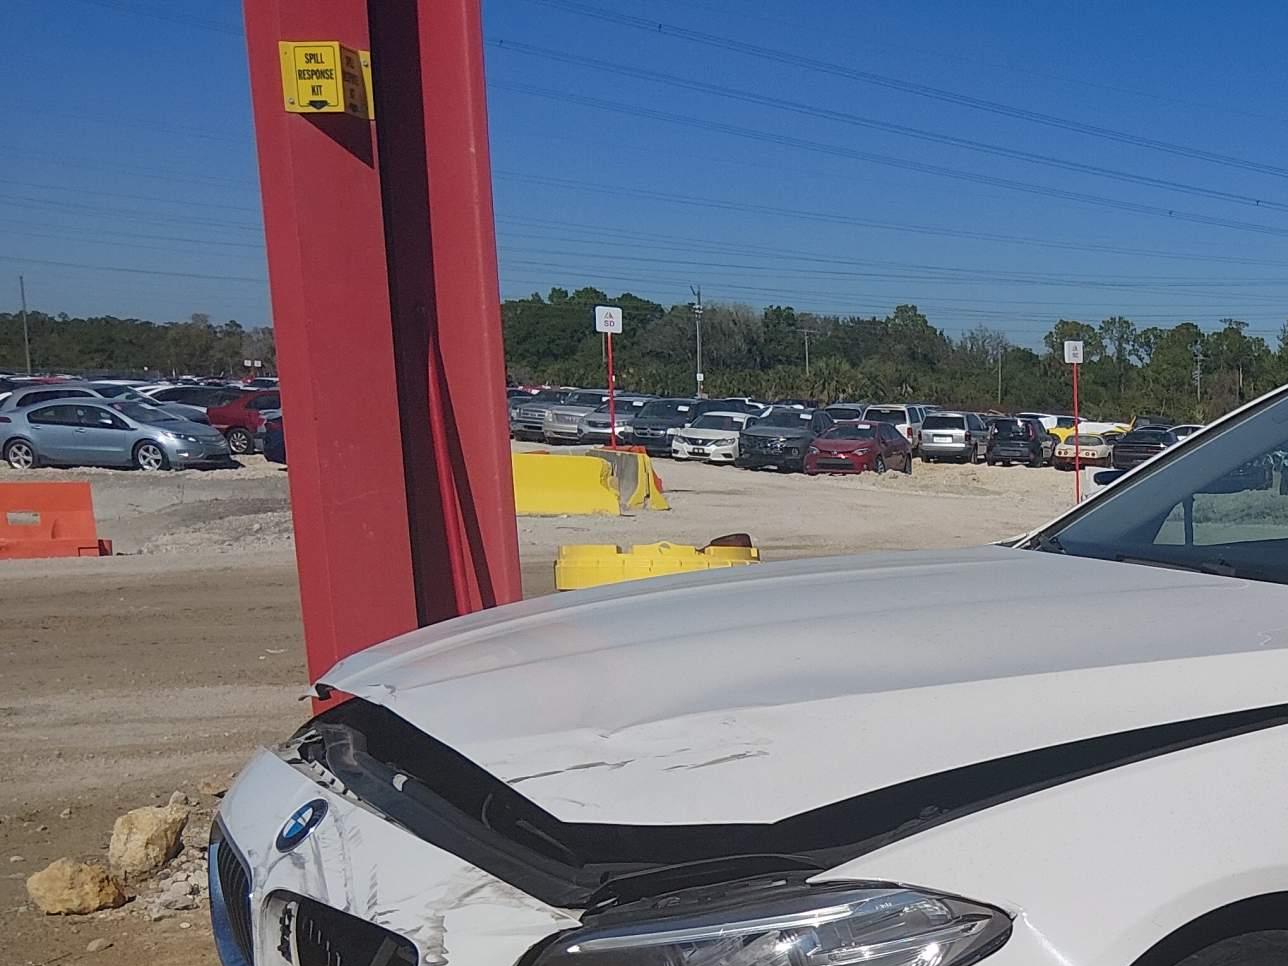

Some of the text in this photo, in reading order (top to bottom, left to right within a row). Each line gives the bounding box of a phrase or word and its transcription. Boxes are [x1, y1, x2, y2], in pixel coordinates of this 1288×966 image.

[303, 52, 325, 65] SPILL
[297, 68, 335, 81] RESPONSE
[311, 84, 323, 96] KIT
